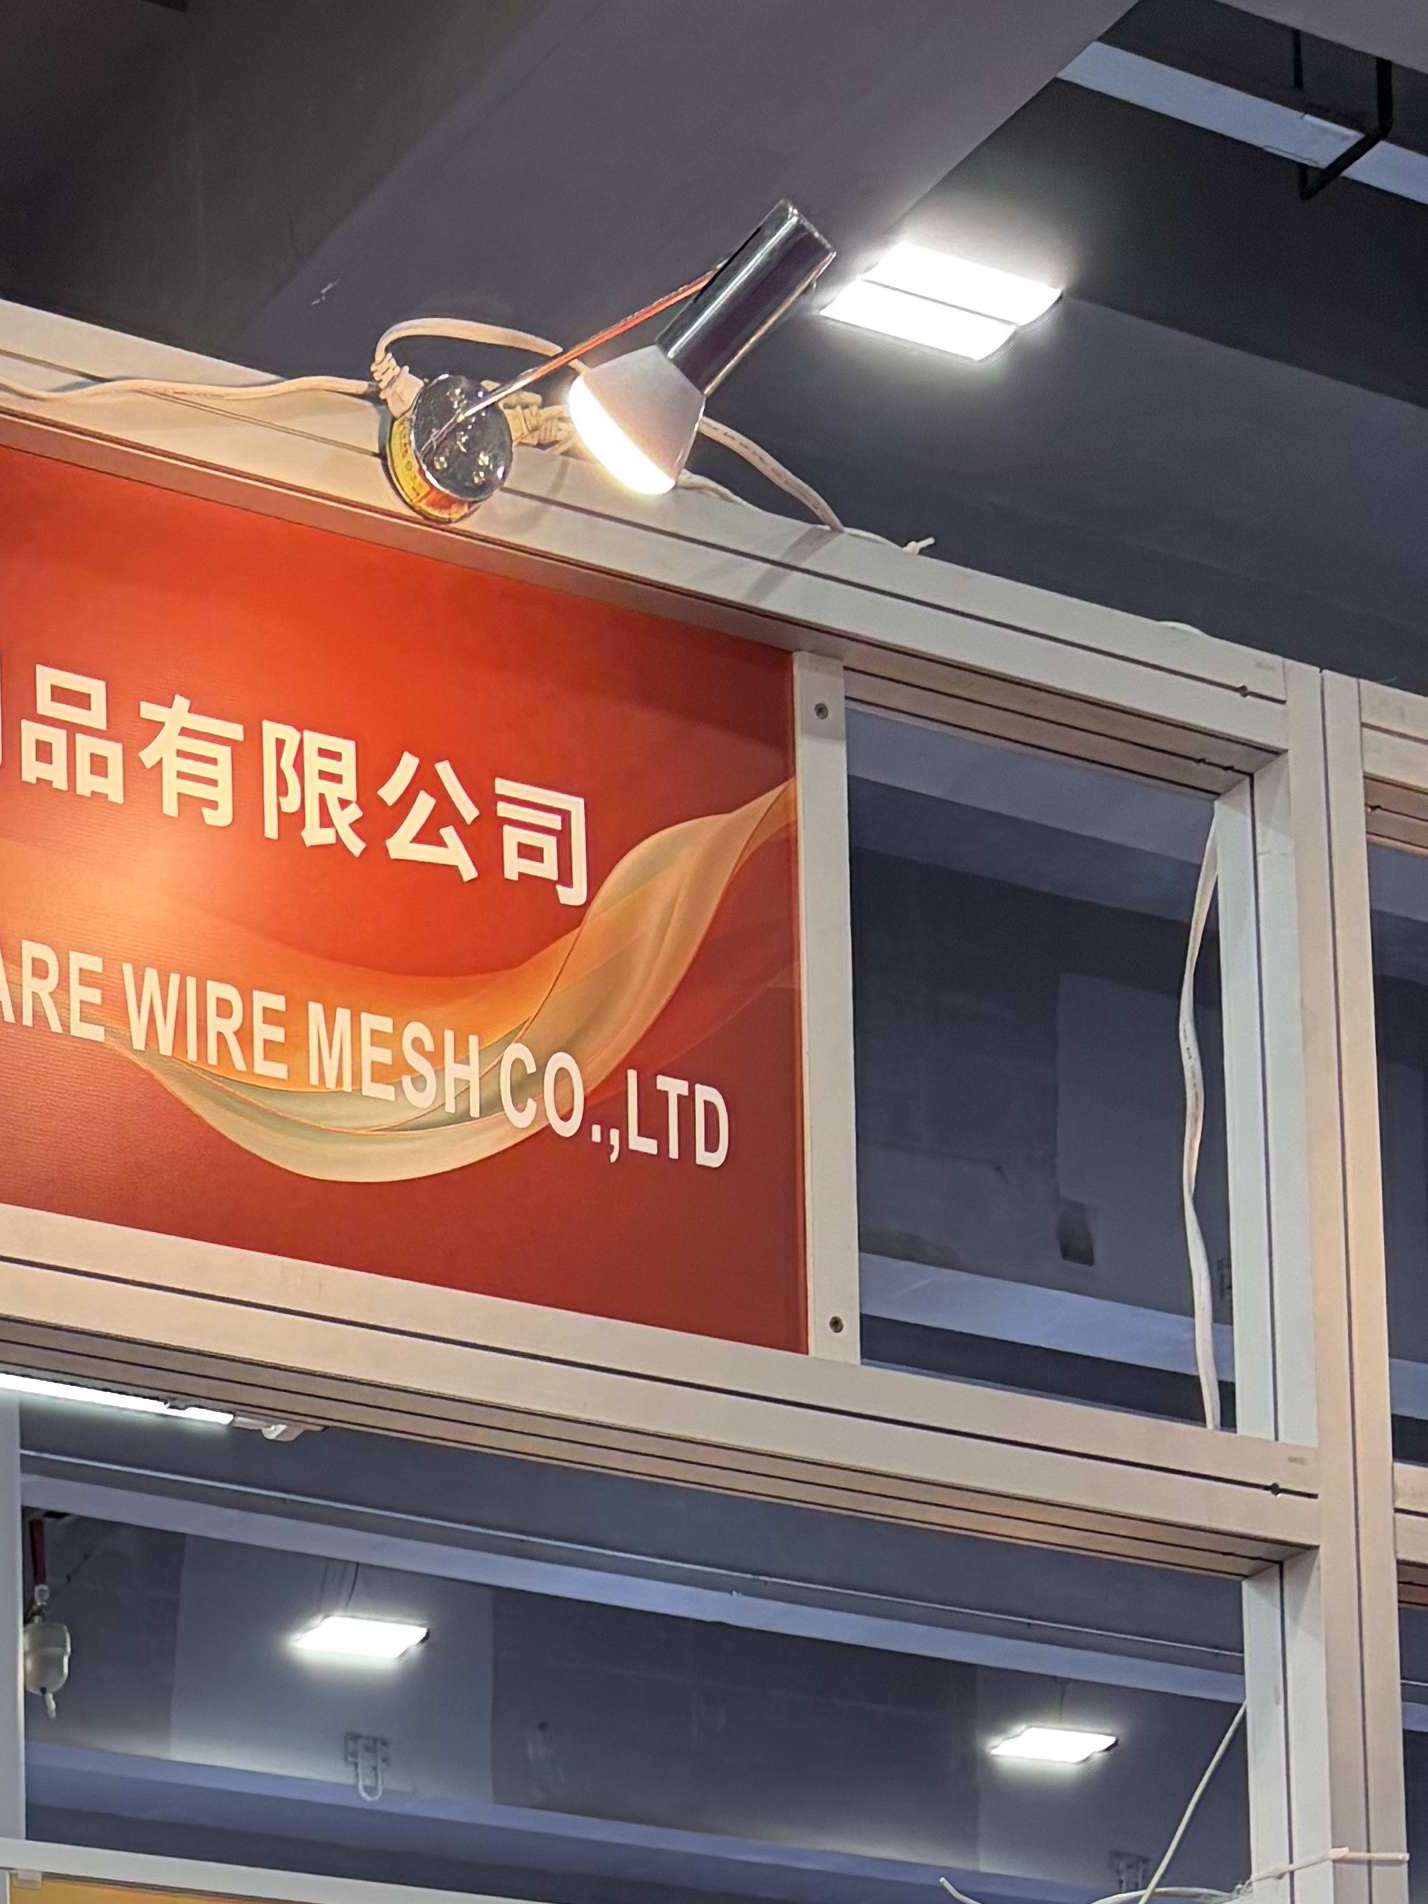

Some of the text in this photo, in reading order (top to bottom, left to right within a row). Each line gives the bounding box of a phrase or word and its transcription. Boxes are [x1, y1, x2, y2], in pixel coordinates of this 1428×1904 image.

[123, 962, 288, 1083] WIRE
[309, 1002, 480, 1117] MESH
[500, 1043, 731, 1168] CO.,LTD
